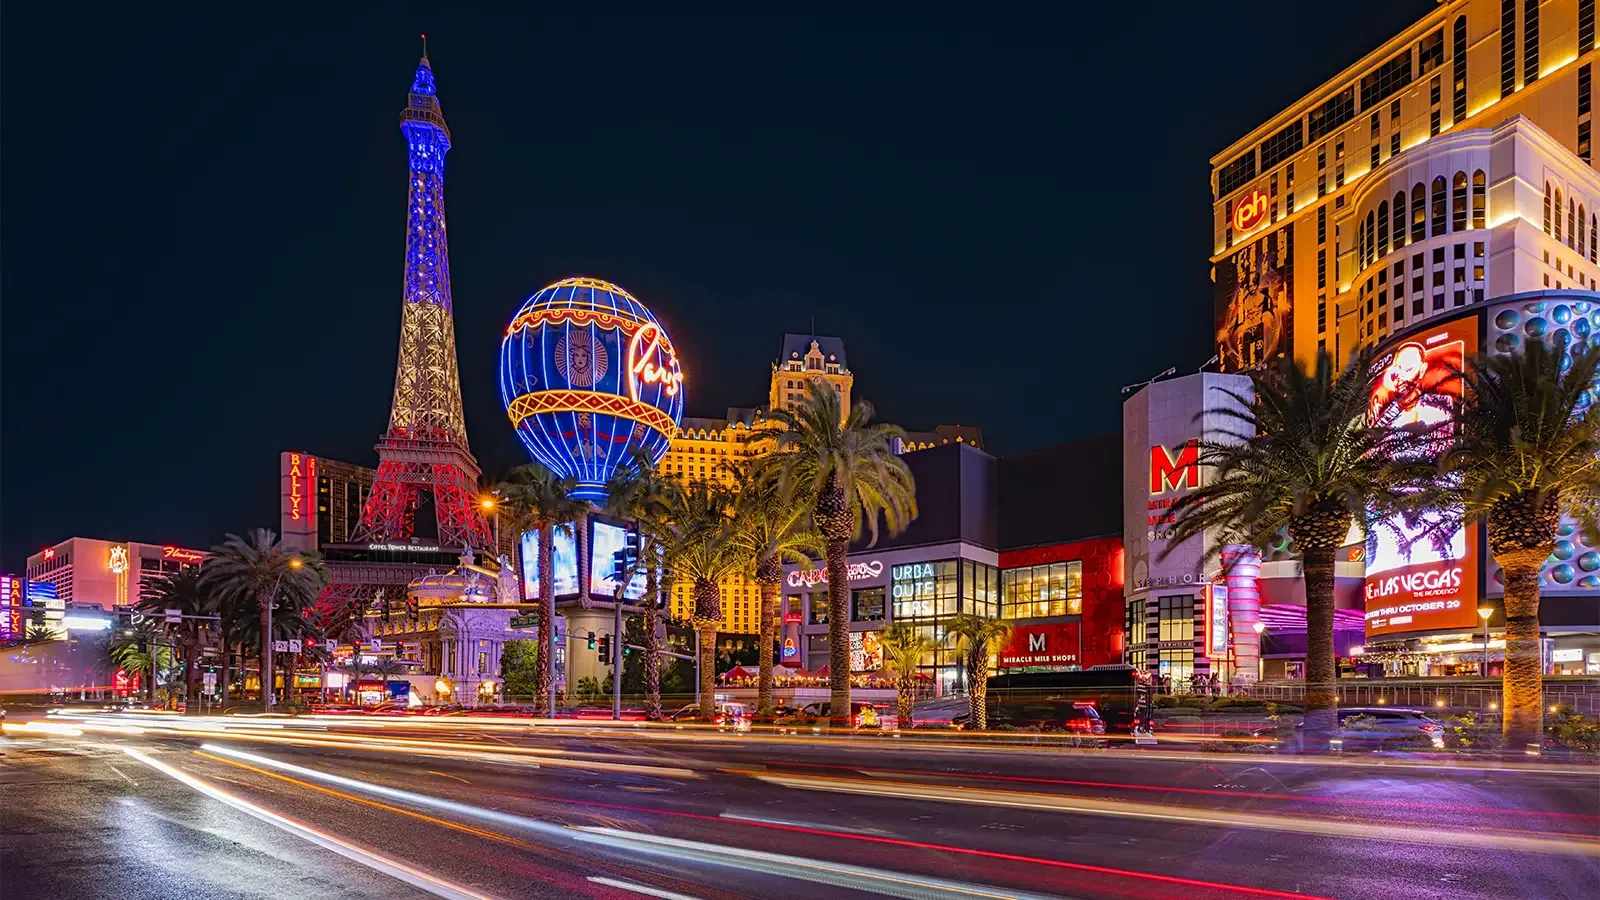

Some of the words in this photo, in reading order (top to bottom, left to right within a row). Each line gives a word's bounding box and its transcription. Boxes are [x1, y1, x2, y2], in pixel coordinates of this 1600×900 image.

[628, 322, 683, 402] Paris
[1151, 438, 1200, 494] M
[1380, 576, 1399, 597] LAS
[1401, 568, 1462, 591] VEGAS
[1399, 601, 1444, 613] OCTOBER
[1028, 632, 1046, 652] M
[1003, 655, 1032, 663] MIRACLE
[1052, 654, 1076, 662] SHOPS
